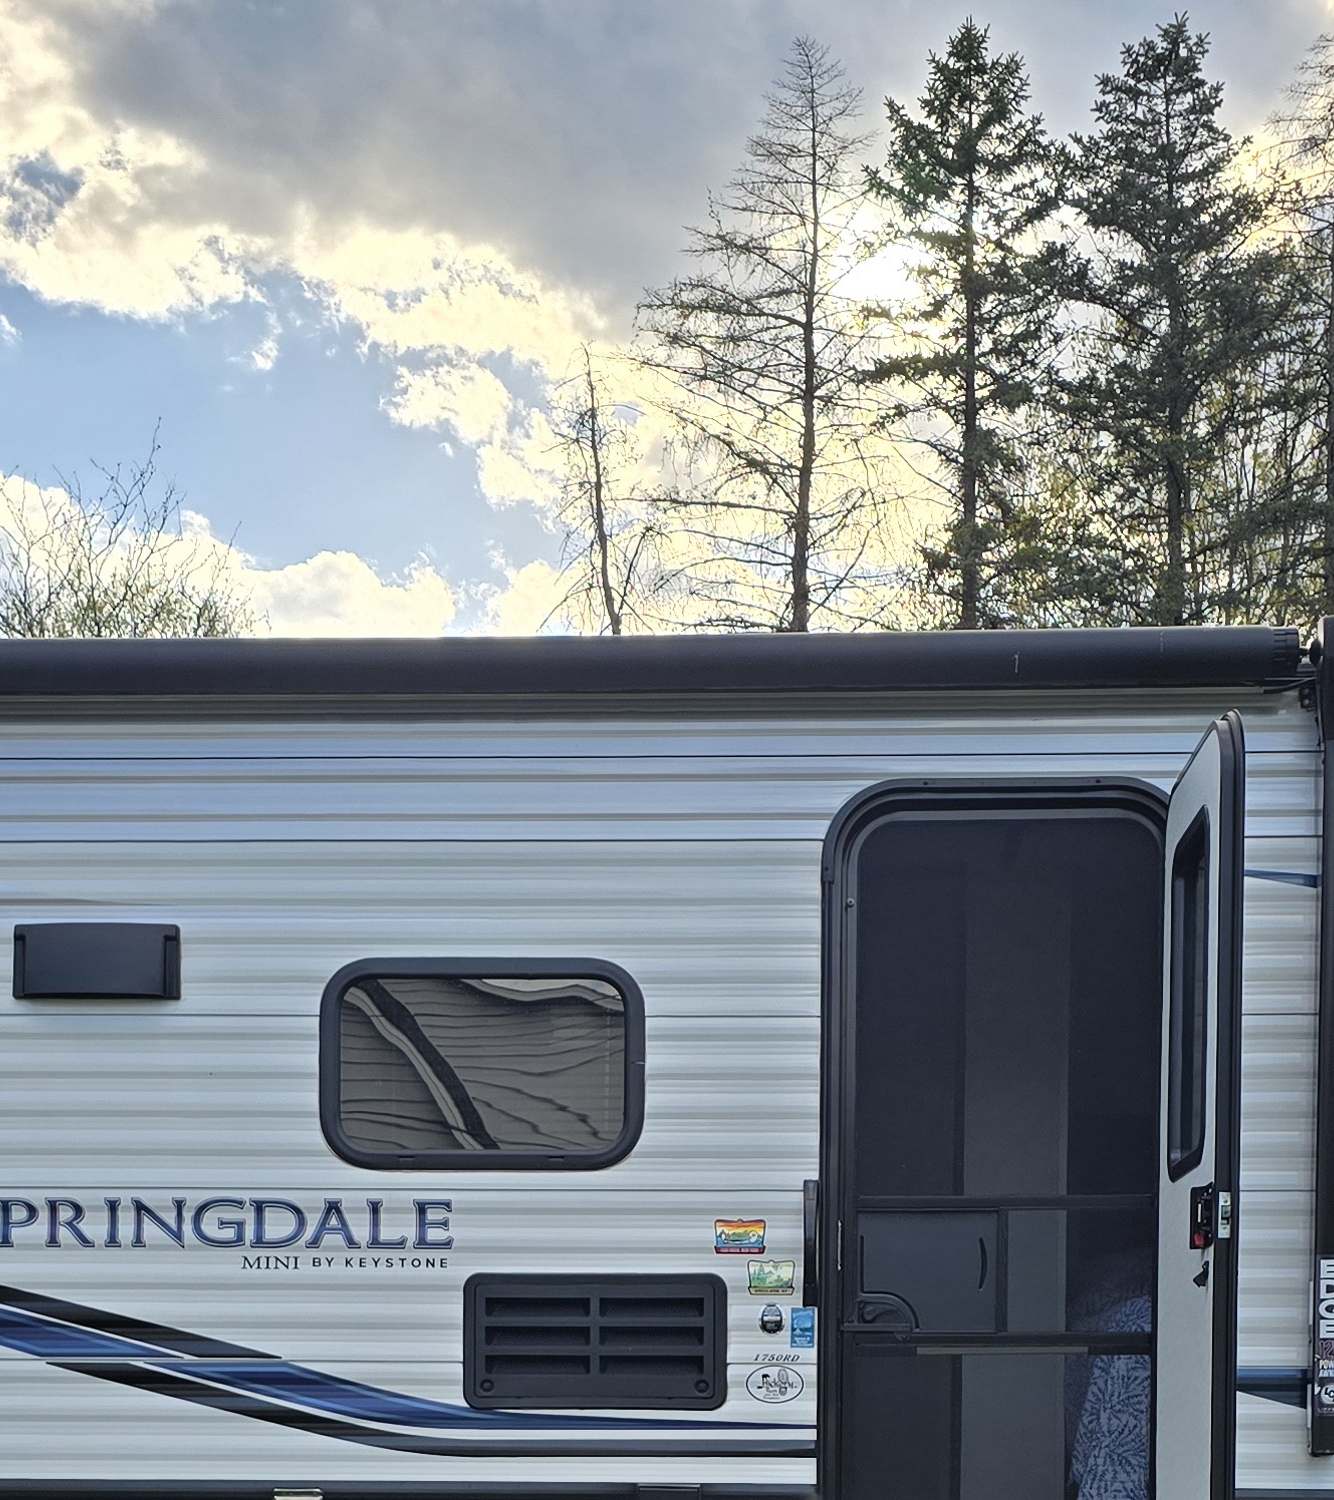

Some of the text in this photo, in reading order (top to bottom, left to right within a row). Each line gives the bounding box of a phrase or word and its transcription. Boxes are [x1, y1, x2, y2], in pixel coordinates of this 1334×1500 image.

[241, 1256, 449, 1270] MINI BY KEYSTONE
[753, 1354, 800, 1362] 1750RD
